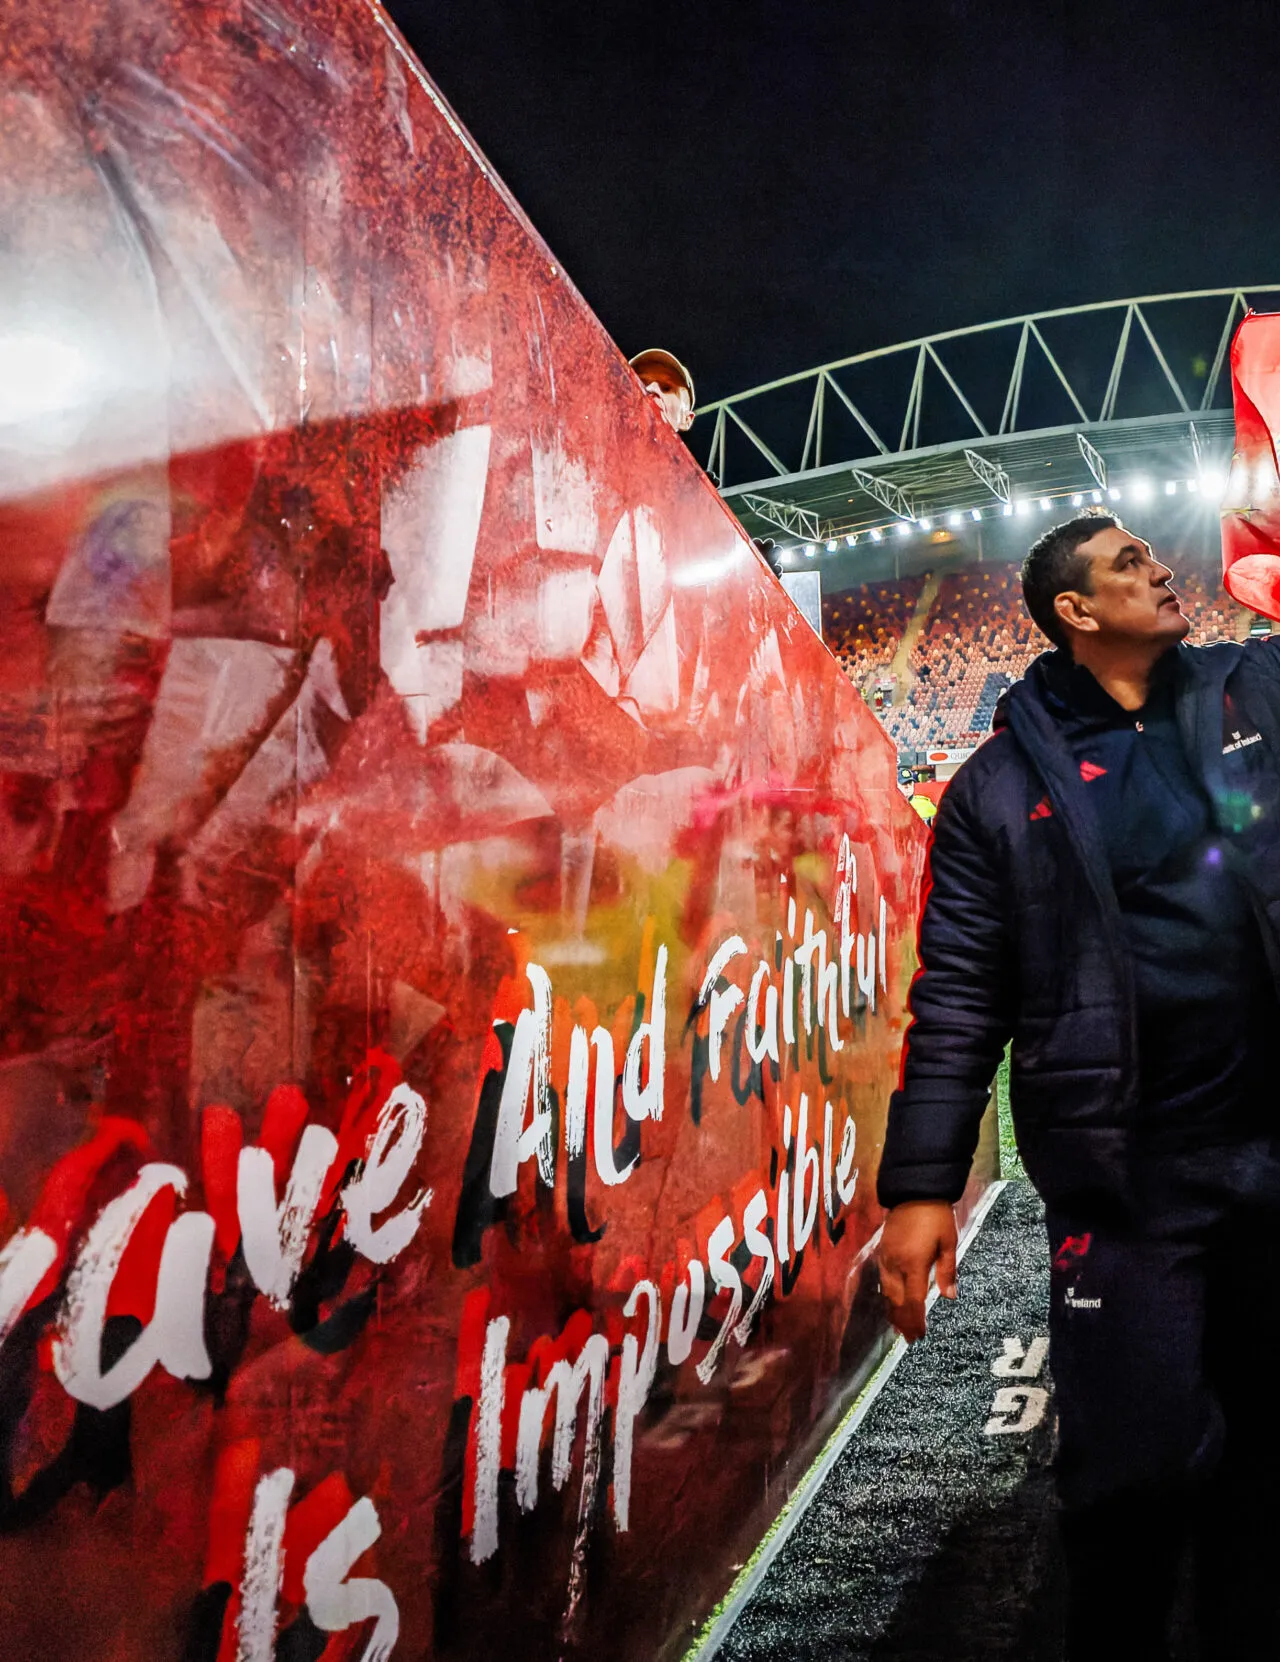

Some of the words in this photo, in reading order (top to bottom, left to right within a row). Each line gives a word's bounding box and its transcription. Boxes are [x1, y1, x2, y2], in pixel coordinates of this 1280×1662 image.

[488, 944, 668, 1199] And
[699, 832, 888, 1083] Faithful
[236, 1467, 401, 1662] Is
[469, 1093, 859, 1642] Impossible
